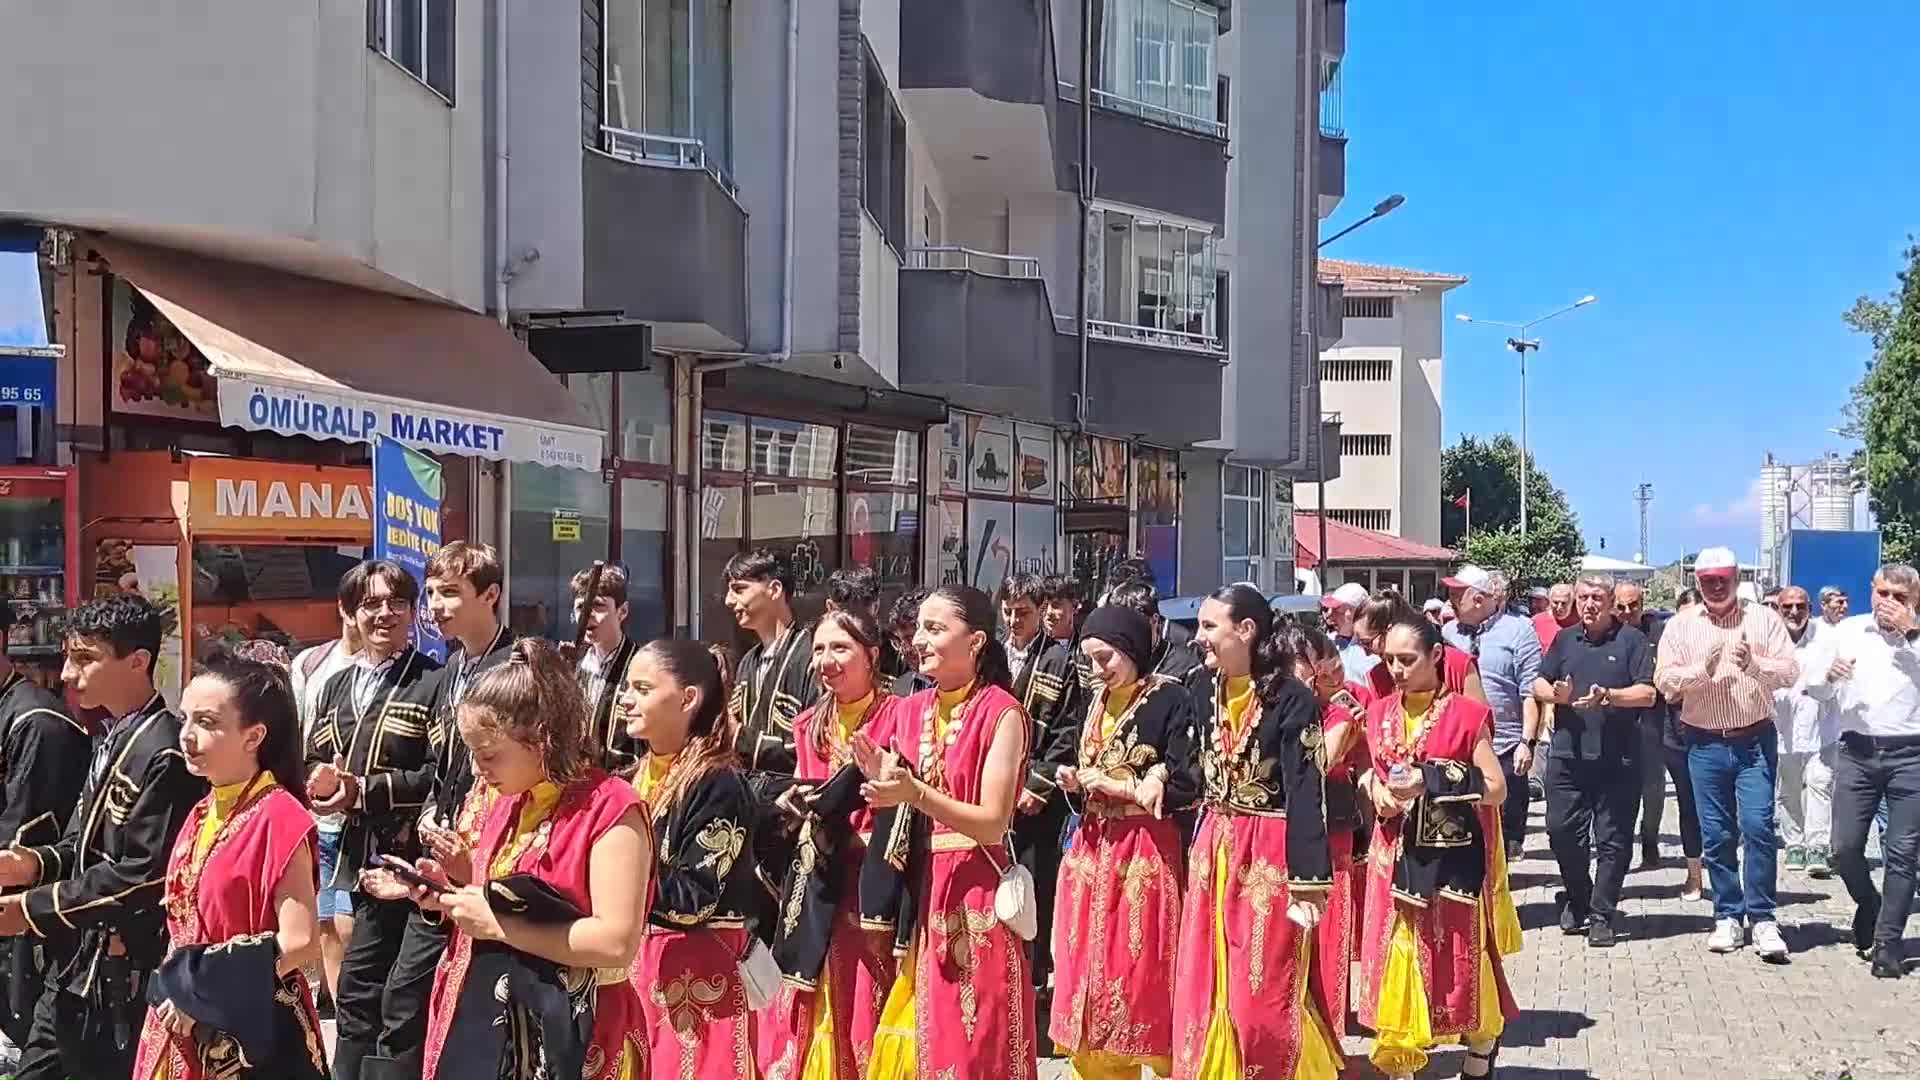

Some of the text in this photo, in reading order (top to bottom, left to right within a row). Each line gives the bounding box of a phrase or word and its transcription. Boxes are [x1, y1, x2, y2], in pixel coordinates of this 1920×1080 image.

[1, 387, 42, 401] 95 65
[249, 387, 505, 452] ÖMÜRALP MARKET
